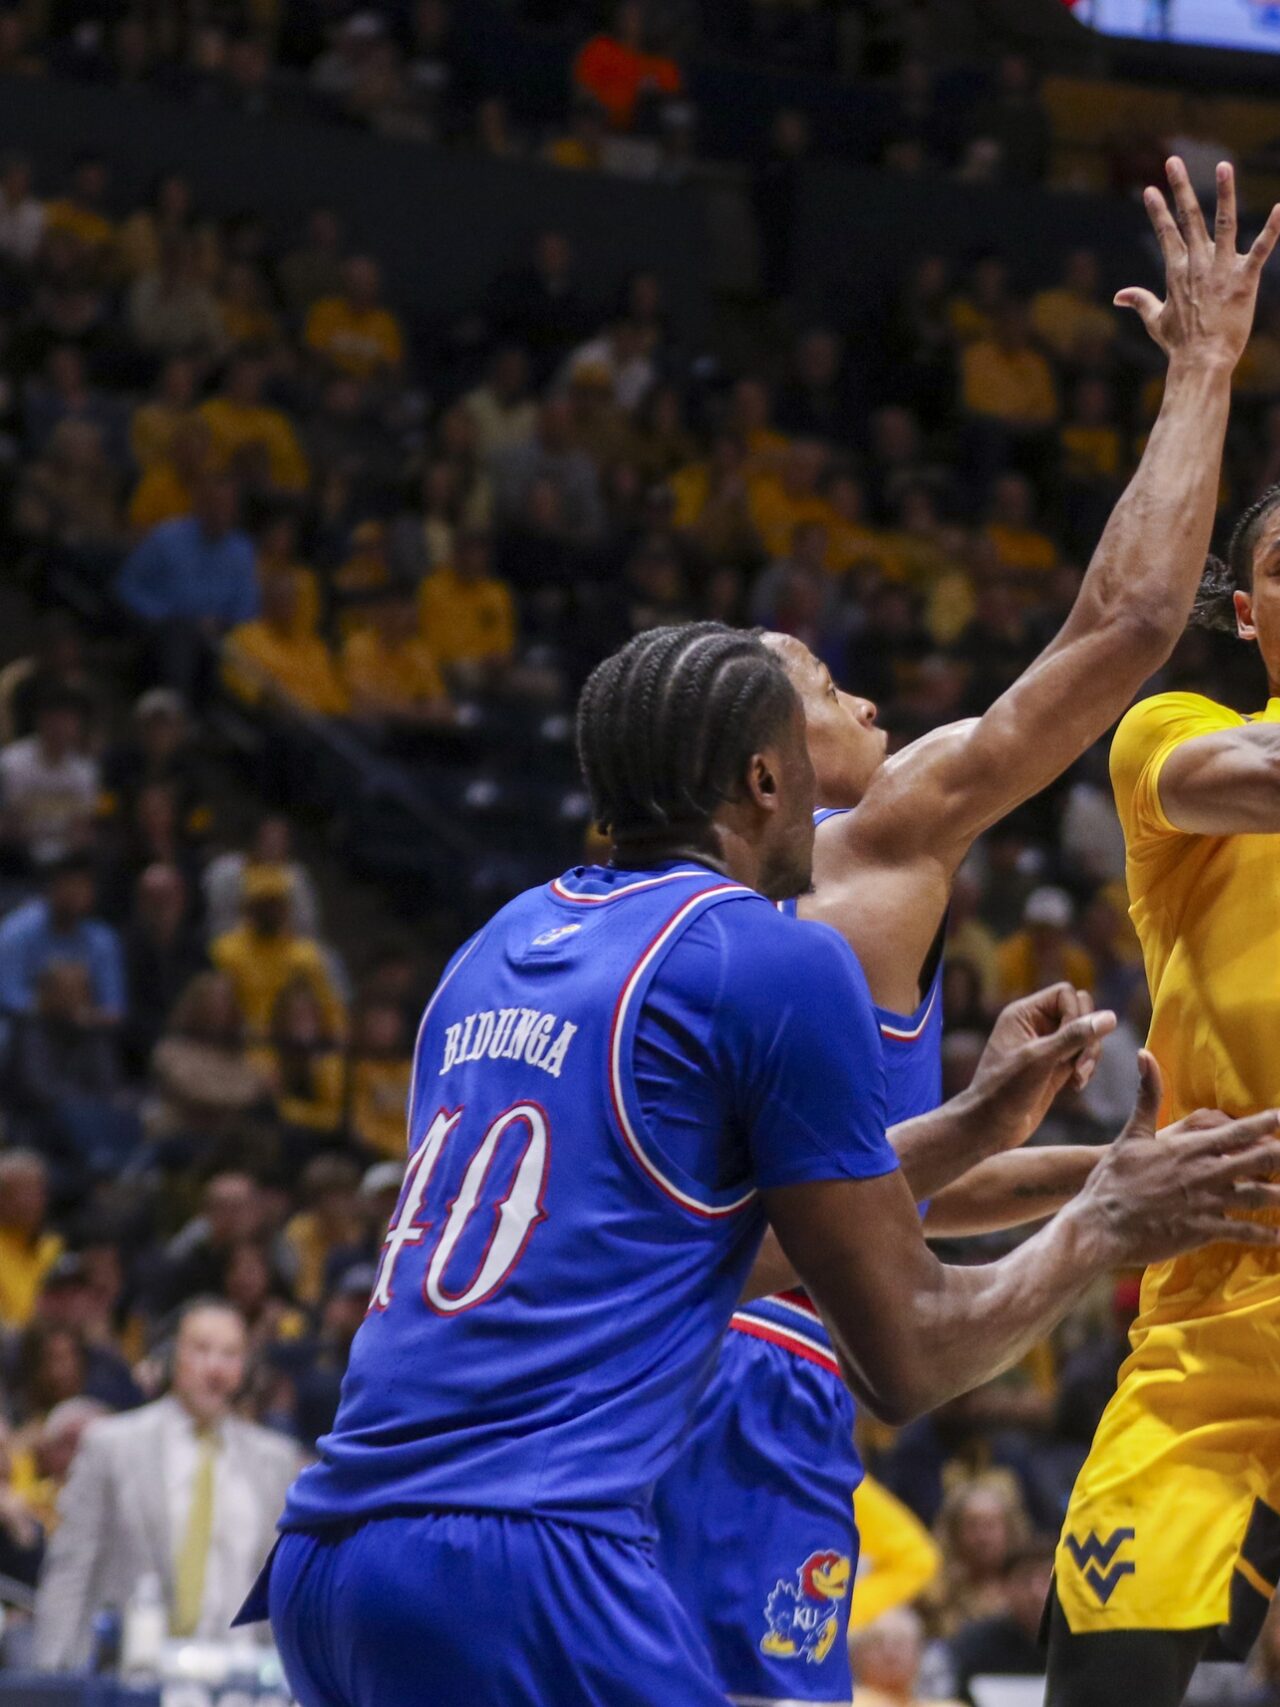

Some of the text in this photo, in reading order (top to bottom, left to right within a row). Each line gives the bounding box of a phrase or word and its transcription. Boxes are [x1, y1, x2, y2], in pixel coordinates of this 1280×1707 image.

[438, 1007, 578, 1078] BIDUNGA
[365, 1099, 549, 1318] 40
[792, 1605, 819, 1632] KU
